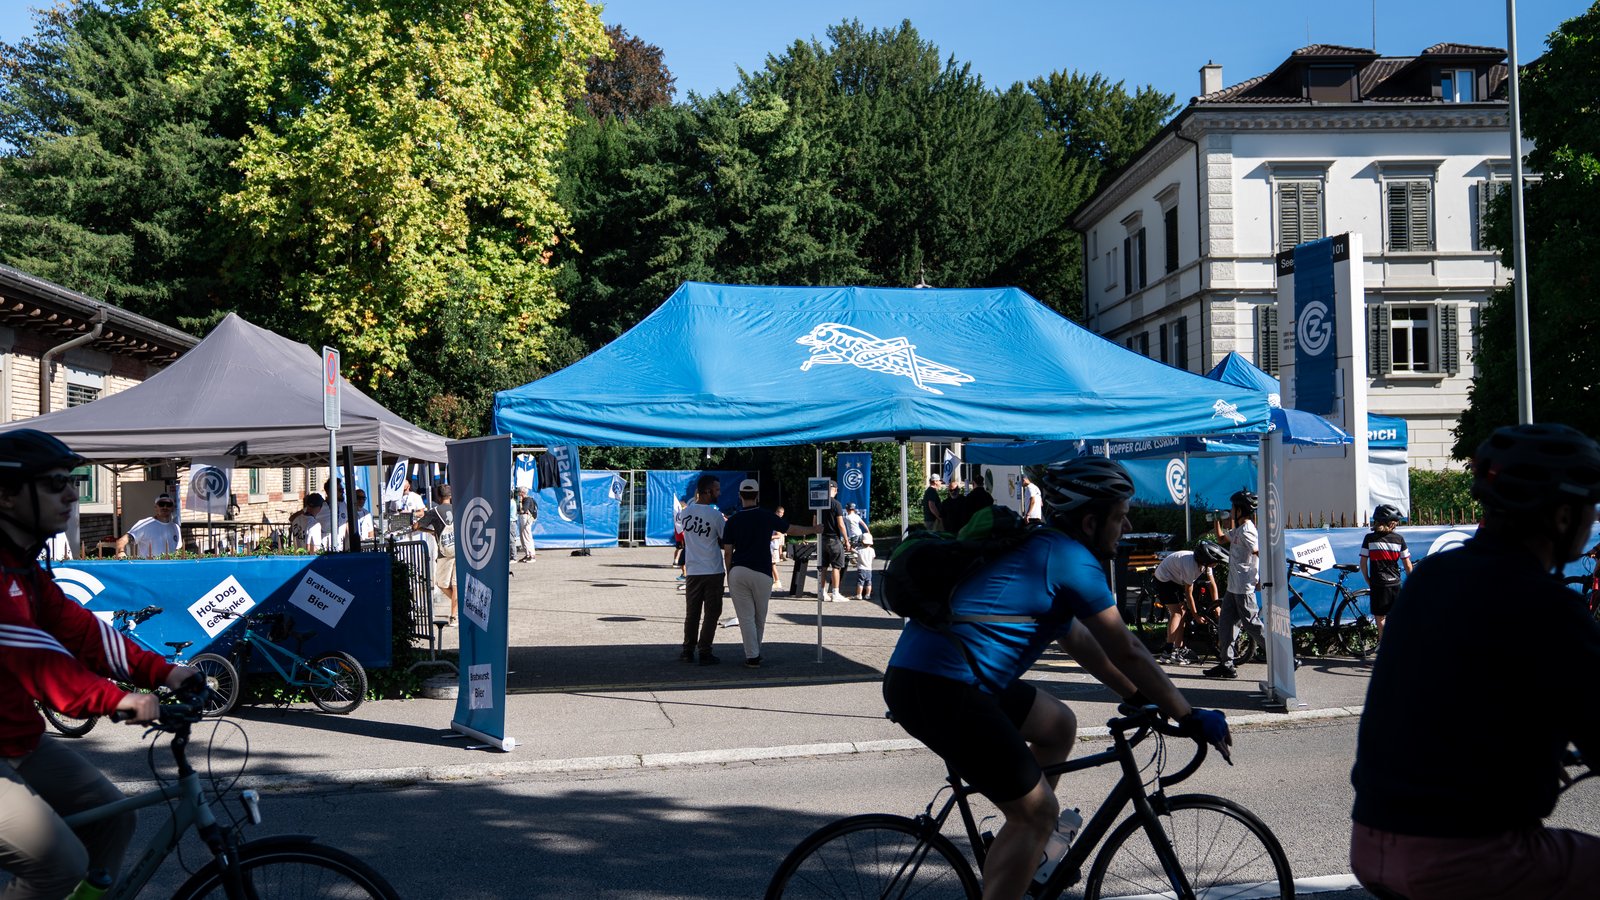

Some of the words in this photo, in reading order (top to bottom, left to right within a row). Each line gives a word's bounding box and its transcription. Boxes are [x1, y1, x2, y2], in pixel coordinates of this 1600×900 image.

[1367, 428, 1397, 441] RICH
[1092, 441, 1134, 455] GRASHOPPER
[1296, 542, 1328, 558] Bratwurst
[1308, 556, 1324, 567] Bier
[305, 576, 347, 606] Bratwurst
[196, 600, 216, 618] Hot
[215, 584, 238, 603] Dog
[307, 594, 329, 612] Bier
[470, 671, 490, 682] Bratwurst
[474, 687, 485, 699] Bier
